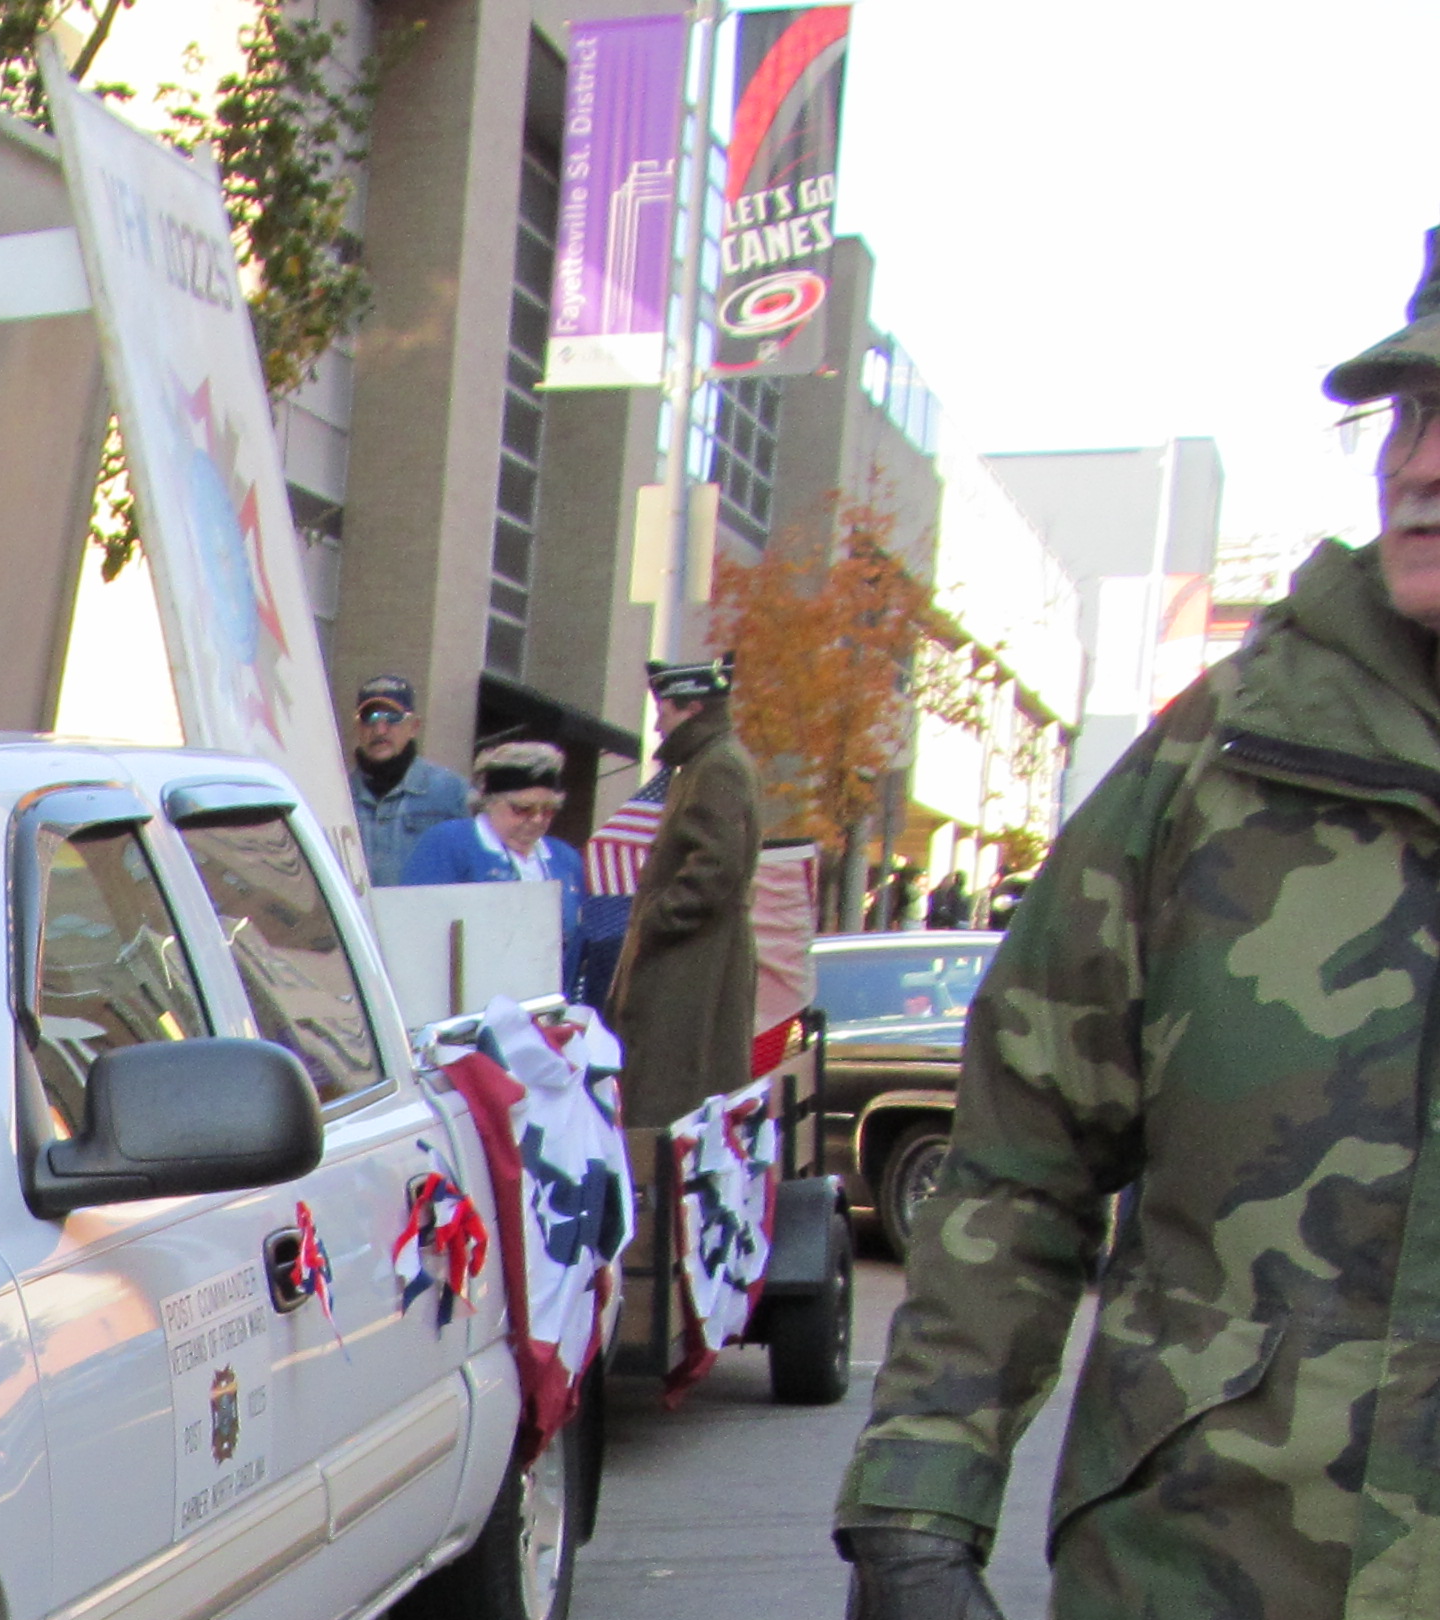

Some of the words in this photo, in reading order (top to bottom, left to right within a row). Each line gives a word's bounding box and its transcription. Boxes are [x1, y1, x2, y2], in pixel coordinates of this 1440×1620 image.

[569, 36, 599, 135] District
[566, 142, 591, 182] St.
[725, 183, 794, 230] LET'S
[798, 172, 835, 212] GO
[555, 185, 589, 333] Fayetteville
[721, 209, 835, 275] CANES
[165, 1294, 193, 1332] POST
